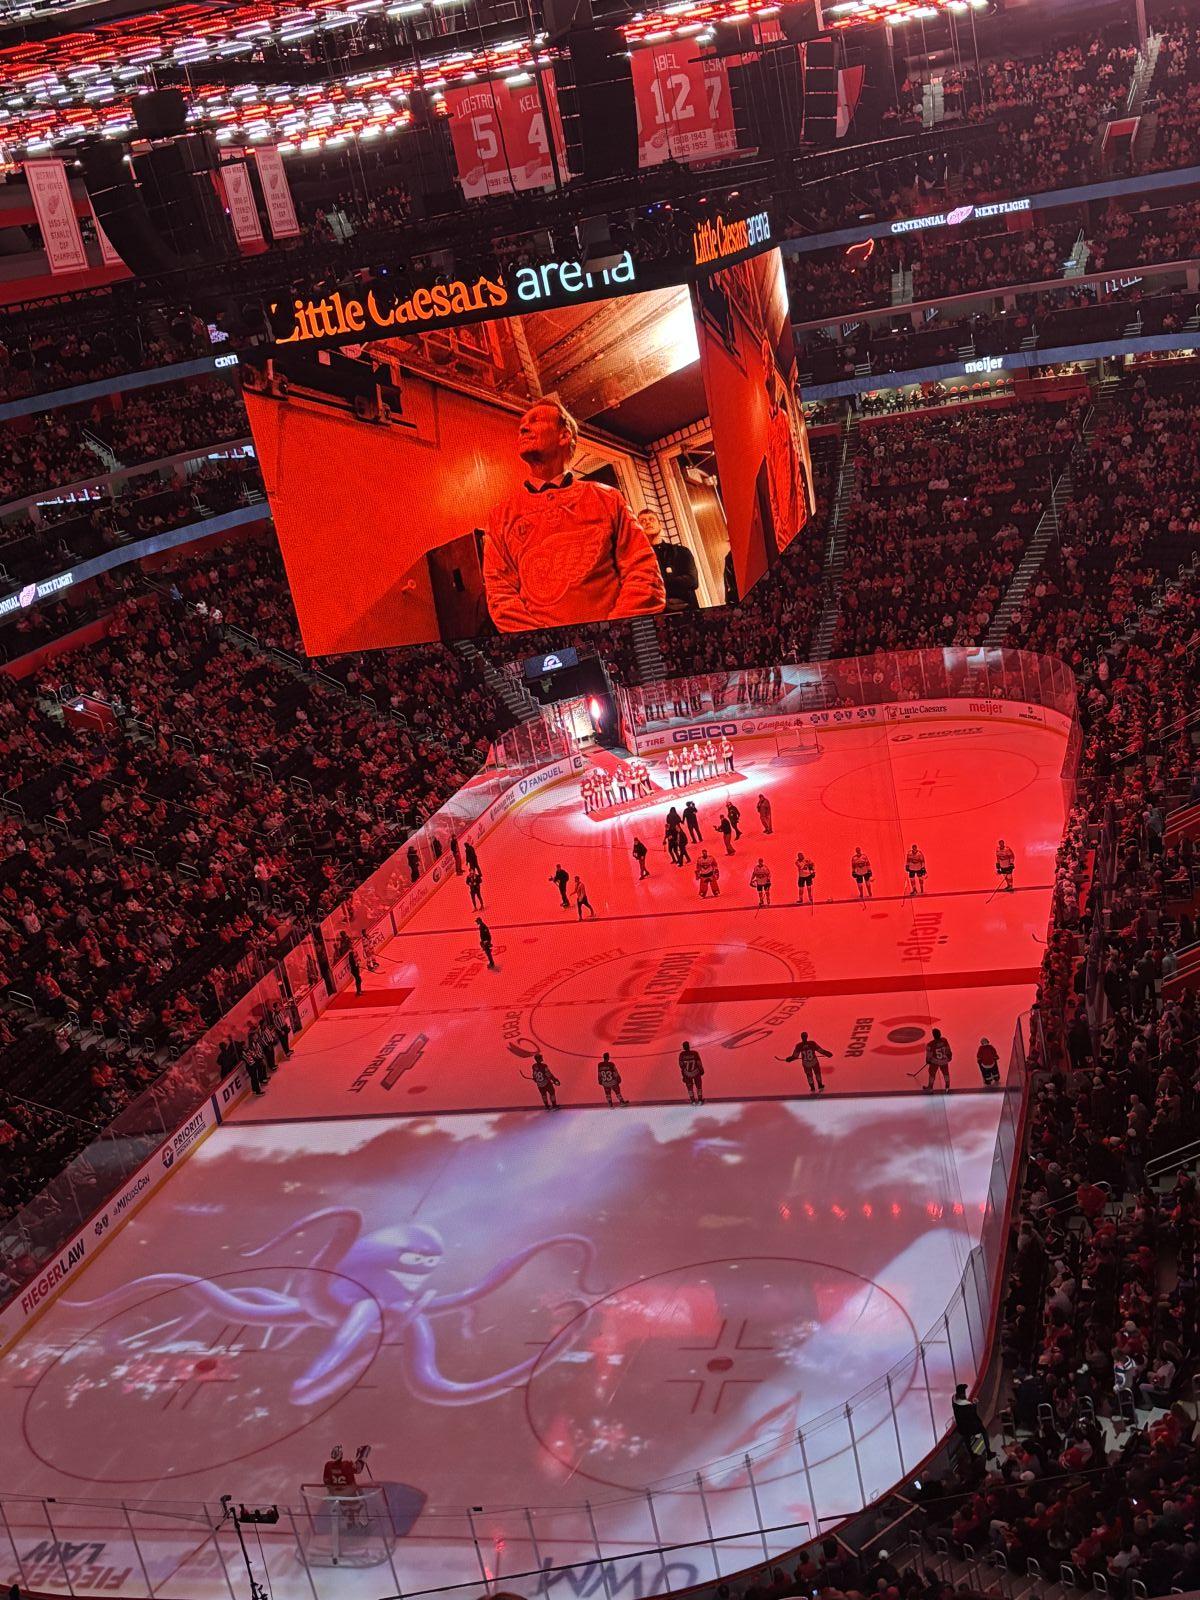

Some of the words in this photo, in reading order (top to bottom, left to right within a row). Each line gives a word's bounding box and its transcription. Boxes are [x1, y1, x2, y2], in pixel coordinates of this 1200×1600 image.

[653, 53, 681, 74] ABEL
[650, 73, 695, 125] 12
[704, 76, 722, 120] 7
[470, 113, 499, 160] 5
[527, 112, 551, 154] 4
[891, 214, 945, 233] CENTENNIAL
[974, 204, 998, 218] NEXT
[998, 198, 1030, 213] FLIGHT
[693, 222, 718, 265] Little
[717, 214, 748, 259] Caesars
[747, 211, 771, 246] arena
[964, 356, 1003, 374] meijer
[919, 704, 948, 714] Caesars
[969, 700, 1003, 716] meijer
[672, 723, 738, 743] GEICO
[529, 766, 564, 788] FANDUEL
[896, 911, 950, 963] meijer
[844, 1017, 874, 1059] BELFOR
[347, 1032, 406, 1094] CHEVROLET
[600, 1070, 613, 1082] 93
[221, 1077, 243, 1104] DTE
[173, 1111, 205, 1150] PRIORITY
[21, 1540, 107, 1565] LAW
